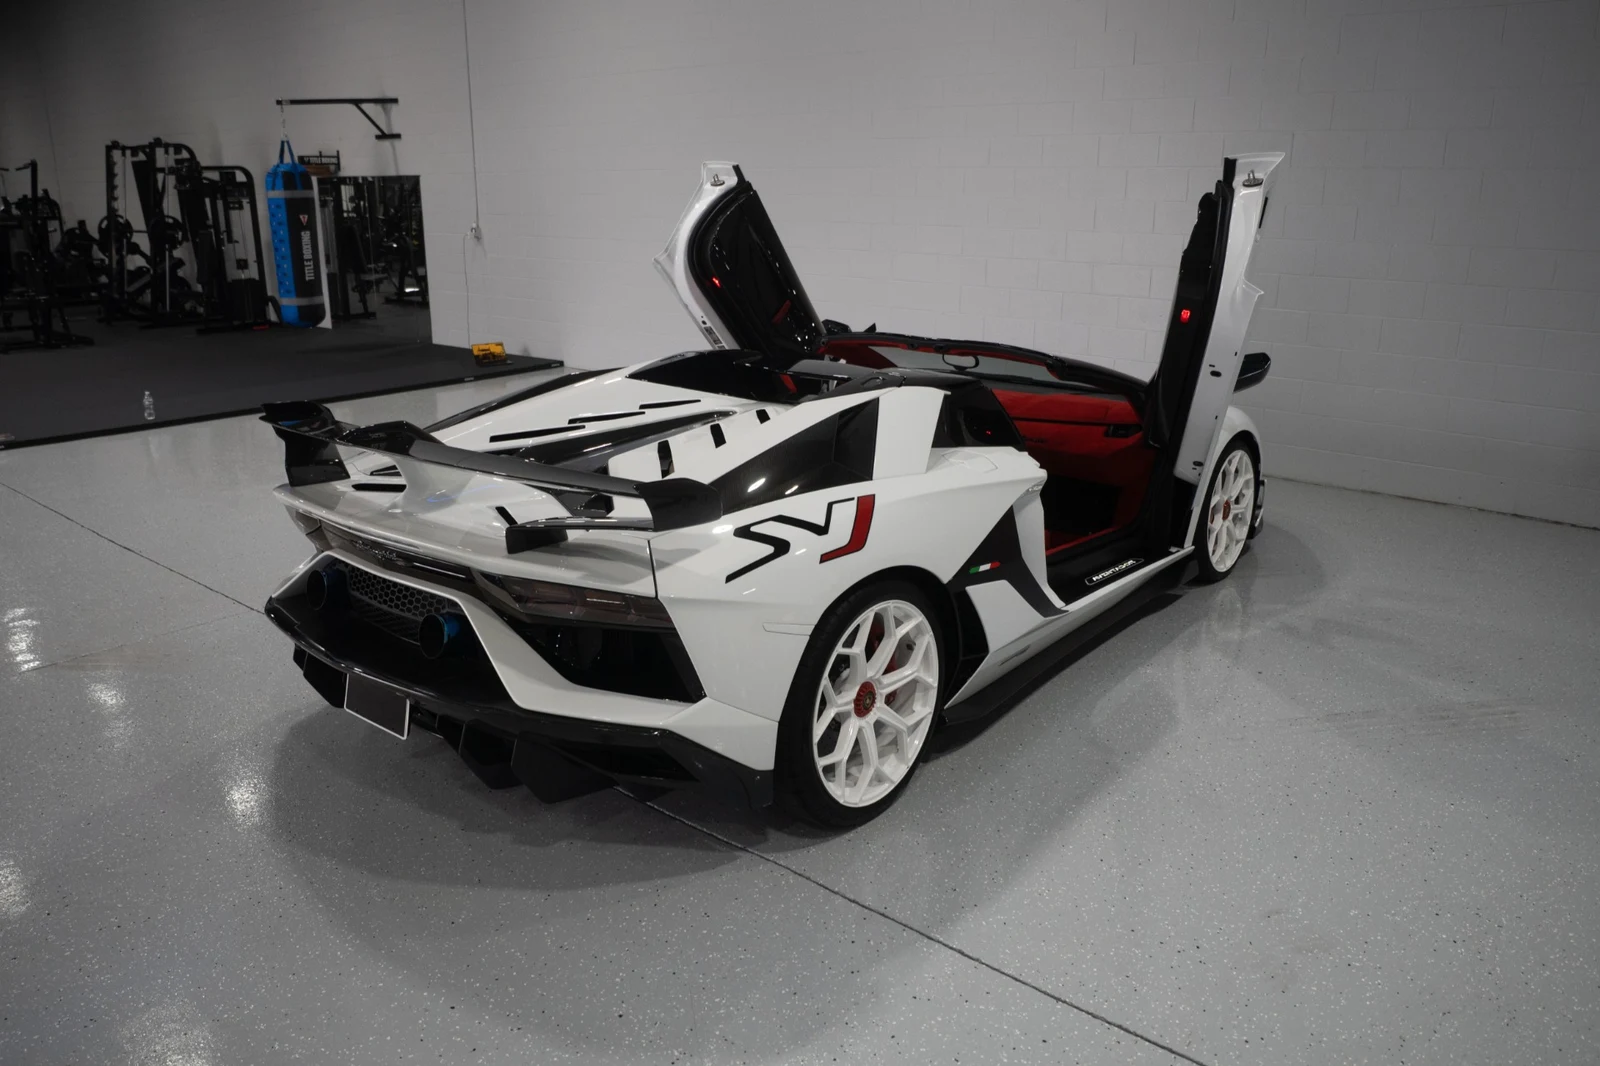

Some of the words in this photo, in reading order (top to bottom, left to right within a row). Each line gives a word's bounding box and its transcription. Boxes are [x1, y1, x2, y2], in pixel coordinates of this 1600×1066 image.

[301, 230, 313, 259] BOXING
[304, 260, 315, 281] TITLE
[725, 494, 876, 584] SVJ
